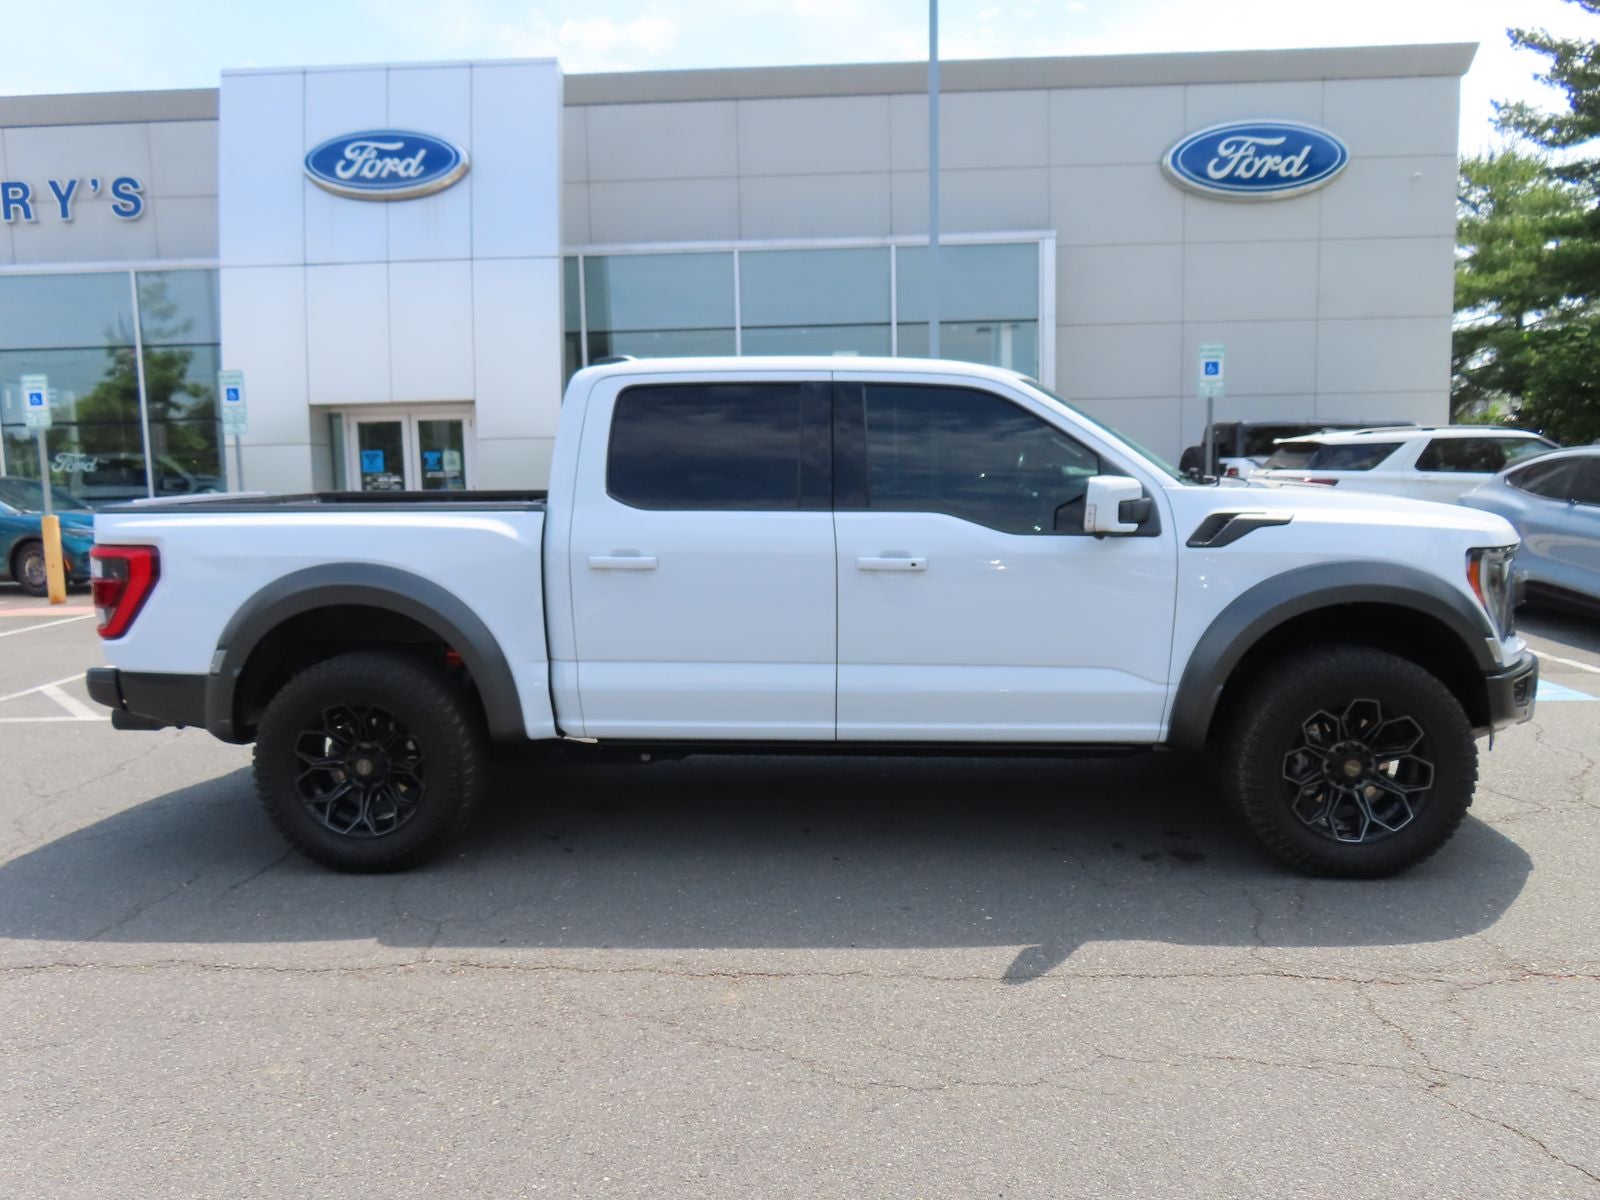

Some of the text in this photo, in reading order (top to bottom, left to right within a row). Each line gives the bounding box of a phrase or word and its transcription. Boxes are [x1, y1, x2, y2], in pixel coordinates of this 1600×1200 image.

[335, 141, 427, 179] Ford
[1206, 135, 1312, 180] Ford
[51, 453, 98, 473] Ford
